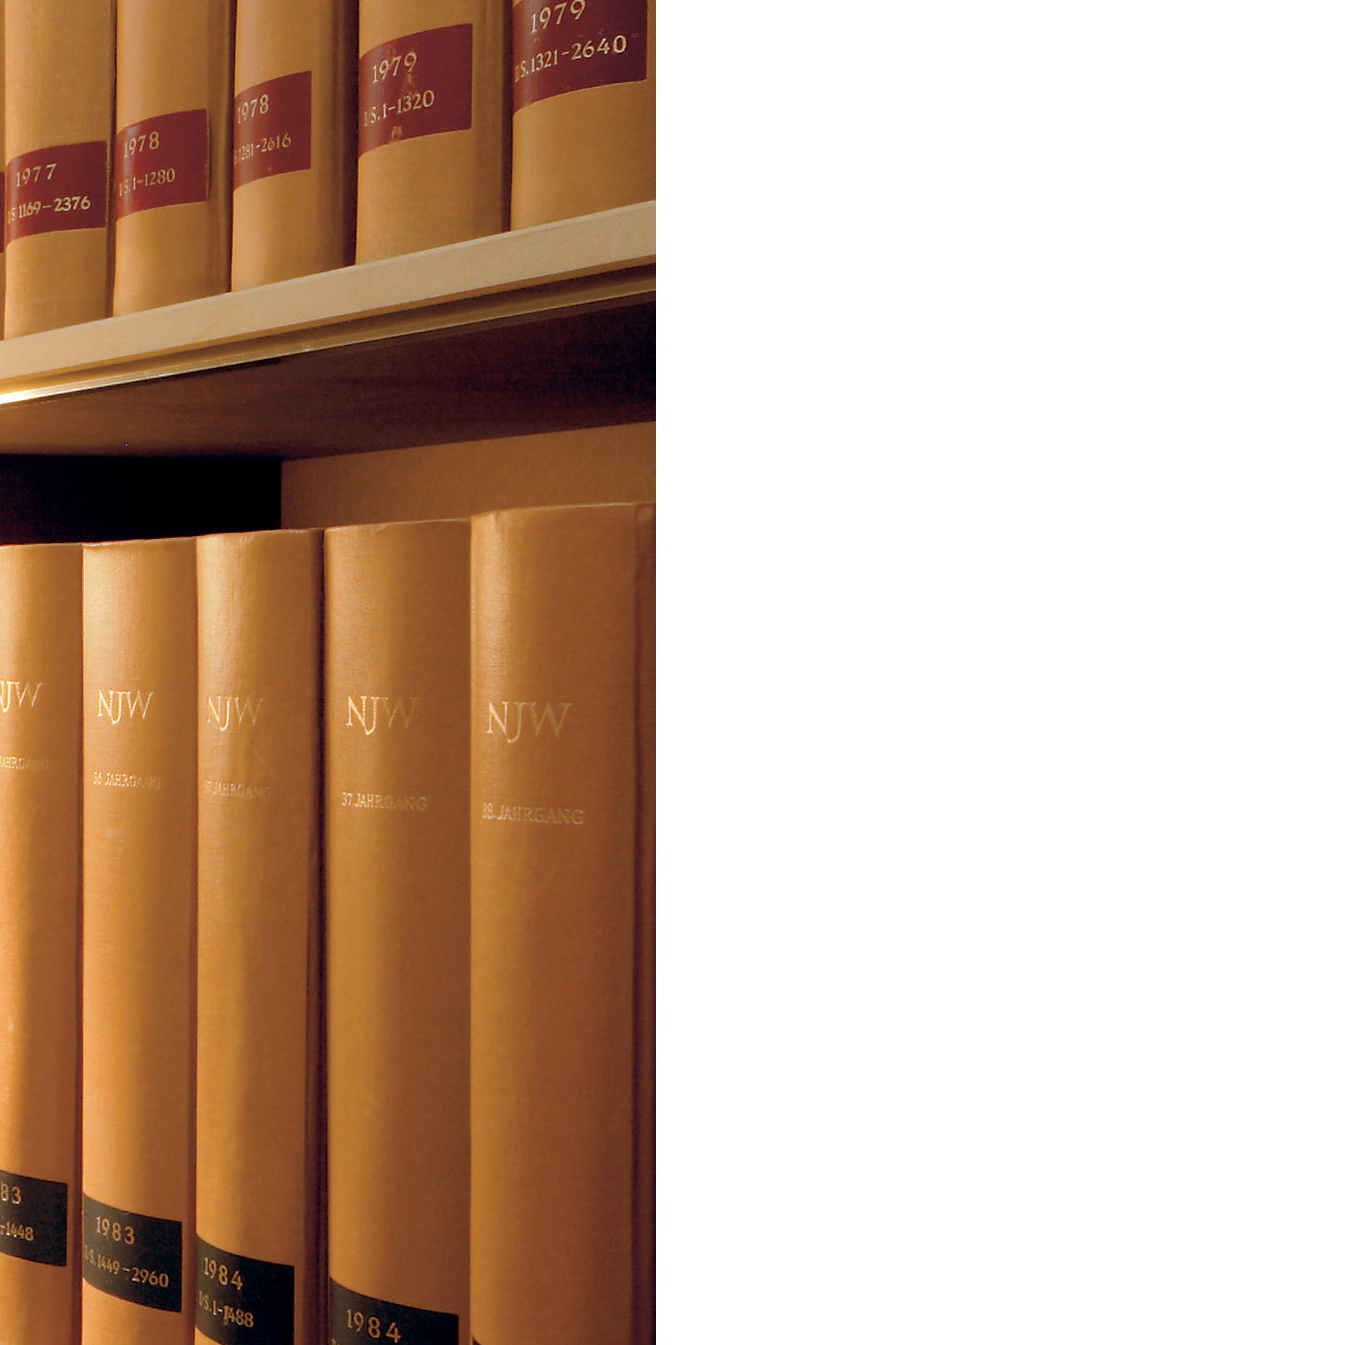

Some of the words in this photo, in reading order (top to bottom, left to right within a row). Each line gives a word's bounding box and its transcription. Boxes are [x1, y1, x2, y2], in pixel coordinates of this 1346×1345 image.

[372, 52, 417, 84] 1979
[238, 94, 269, 124] 1978
[125, 132, 159, 158] 1978
[16, 163, 57, 187] 1977
[97, 689, 153, 725] NJW
[207, 695, 263, 732] NJW
[346, 695, 419, 736] NJW
[486, 701, 573, 744] NJW
[96, 1216, 135, 1246] 1983
[204, 1257, 244, 1291] 1984
[346, 1308, 401, 1344] 1984
